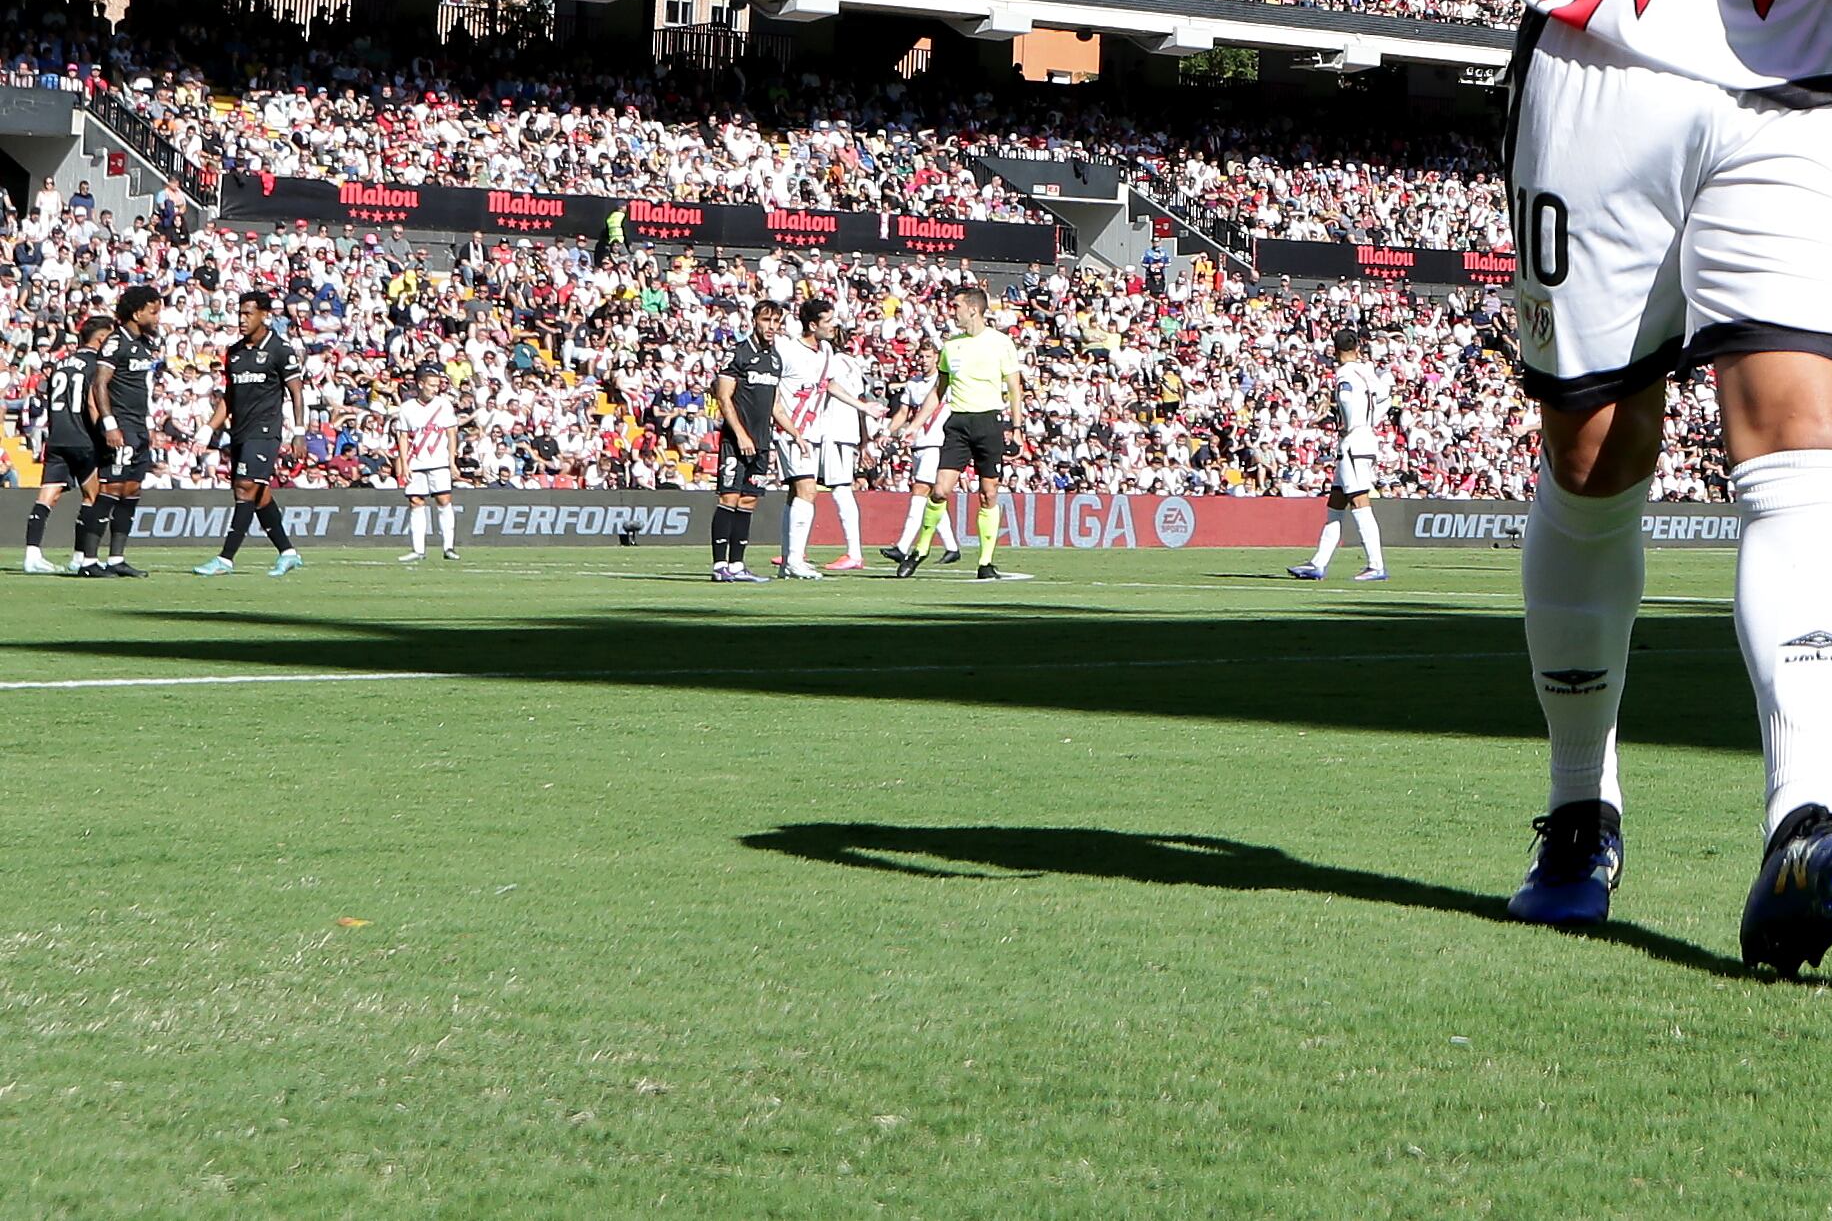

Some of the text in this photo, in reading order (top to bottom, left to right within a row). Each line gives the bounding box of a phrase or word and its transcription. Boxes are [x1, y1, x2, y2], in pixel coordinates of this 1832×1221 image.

[339, 182, 419, 208] Mahou
[488, 190, 564, 217] Mahou
[629, 199, 703, 226] Mahou
[767, 208, 837, 233] Mahou
[898, 215, 965, 241] Mahou
[1517, 185, 1569, 286] 10
[1357, 244, 1415, 267] Mahou
[1463, 251, 1517, 272] Mahou
[51, 371, 85, 414] 21
[116, 446, 134, 466] 12
[129, 506, 339, 538] COMRT
[472, 506, 691, 536] PERFORMS
[956, 493, 1137, 549] LALIGA
[1162, 507, 1188, 524] EA
[1641, 515, 1742, 540] PERFOR
[1544, 682, 1608, 696] umbro
